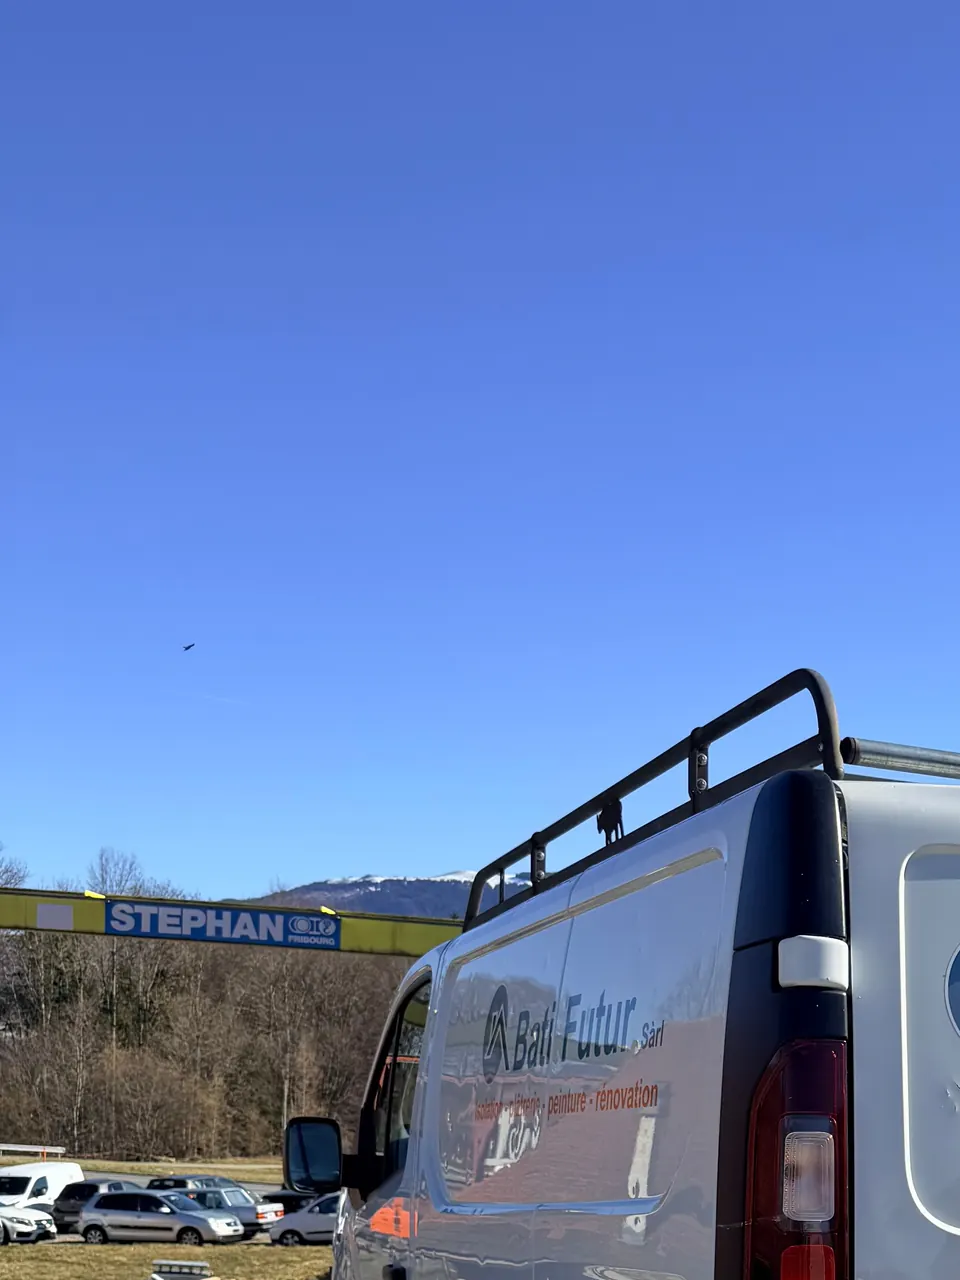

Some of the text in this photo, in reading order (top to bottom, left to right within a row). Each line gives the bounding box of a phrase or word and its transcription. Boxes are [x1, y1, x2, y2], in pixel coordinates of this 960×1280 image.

[110, 903, 284, 942] STEPHAN
[513, 1001, 557, 1071] Bati
[561, 990, 637, 1062] Futur
[548, 1085, 587, 1120] peinture
[595, 1078, 659, 1111] rénovation
